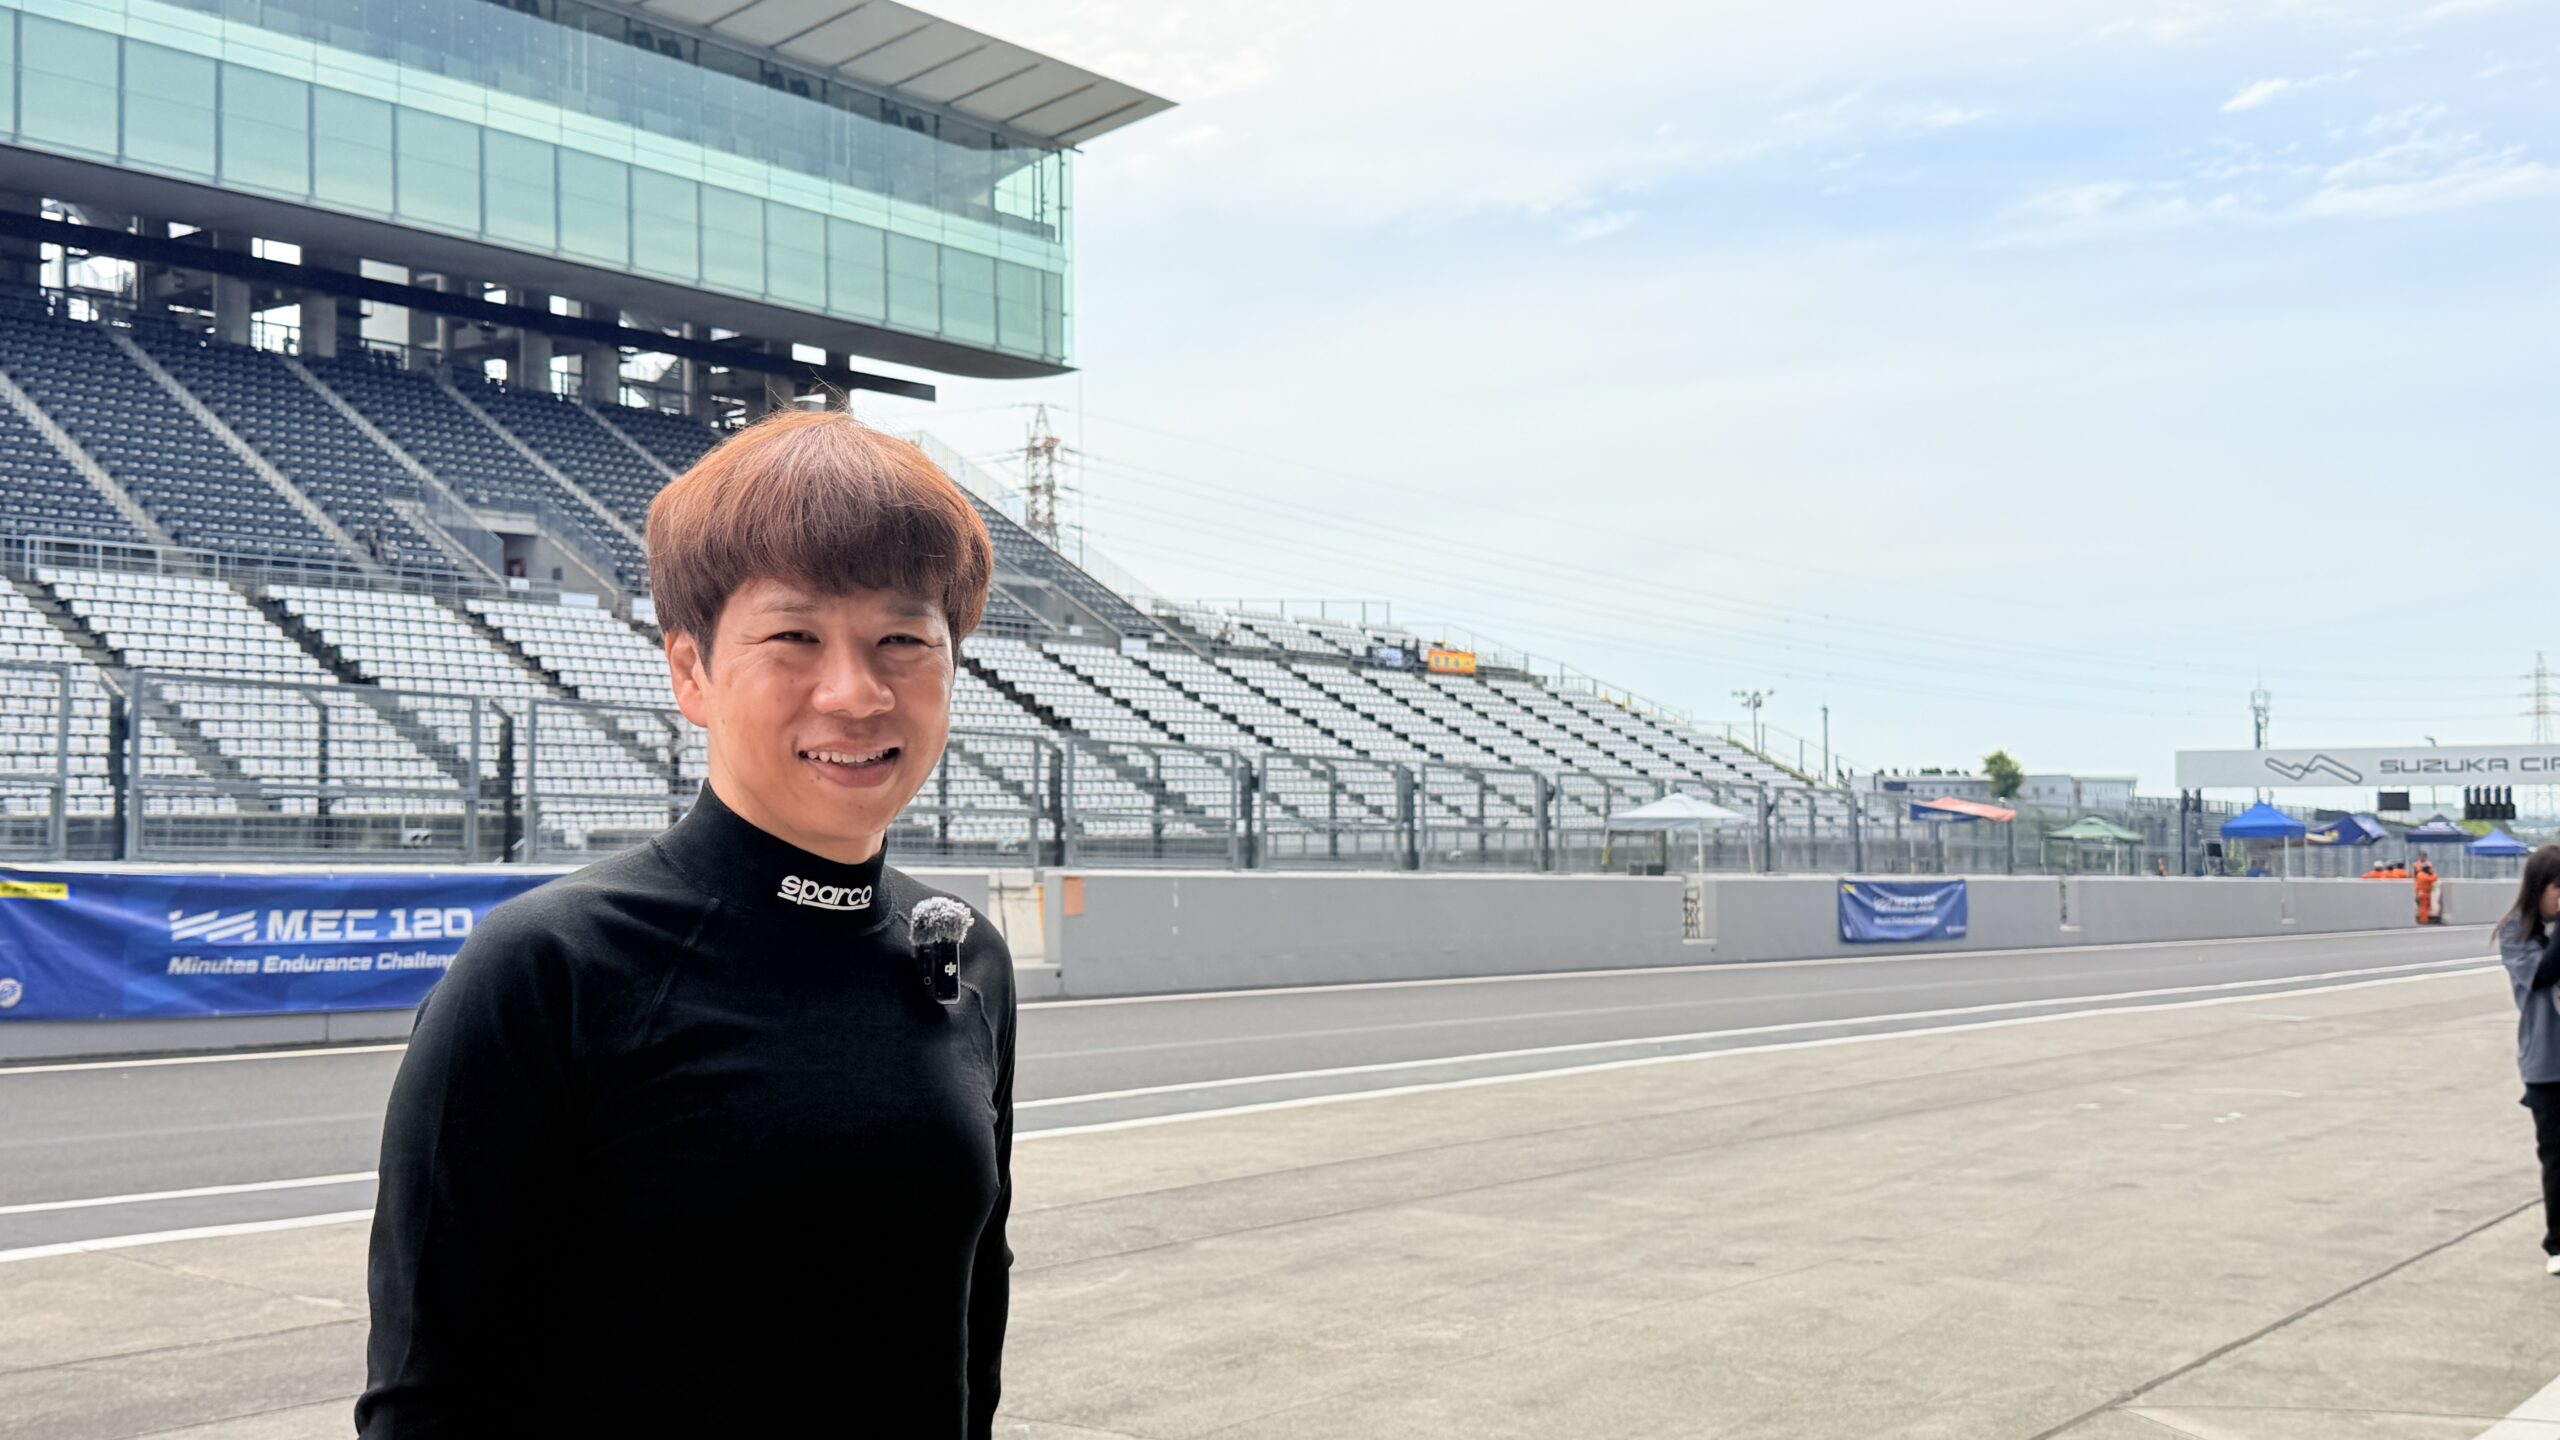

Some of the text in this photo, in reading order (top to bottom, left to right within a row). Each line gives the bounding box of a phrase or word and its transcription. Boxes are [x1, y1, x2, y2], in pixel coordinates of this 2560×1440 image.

[2379, 757, 2509, 774] SUZUKA
[778, 875, 873, 910] sparco
[267, 907, 473, 941] MEC 120
[167, 956, 259, 975] Minutes
[263, 953, 373, 973] Endurance
